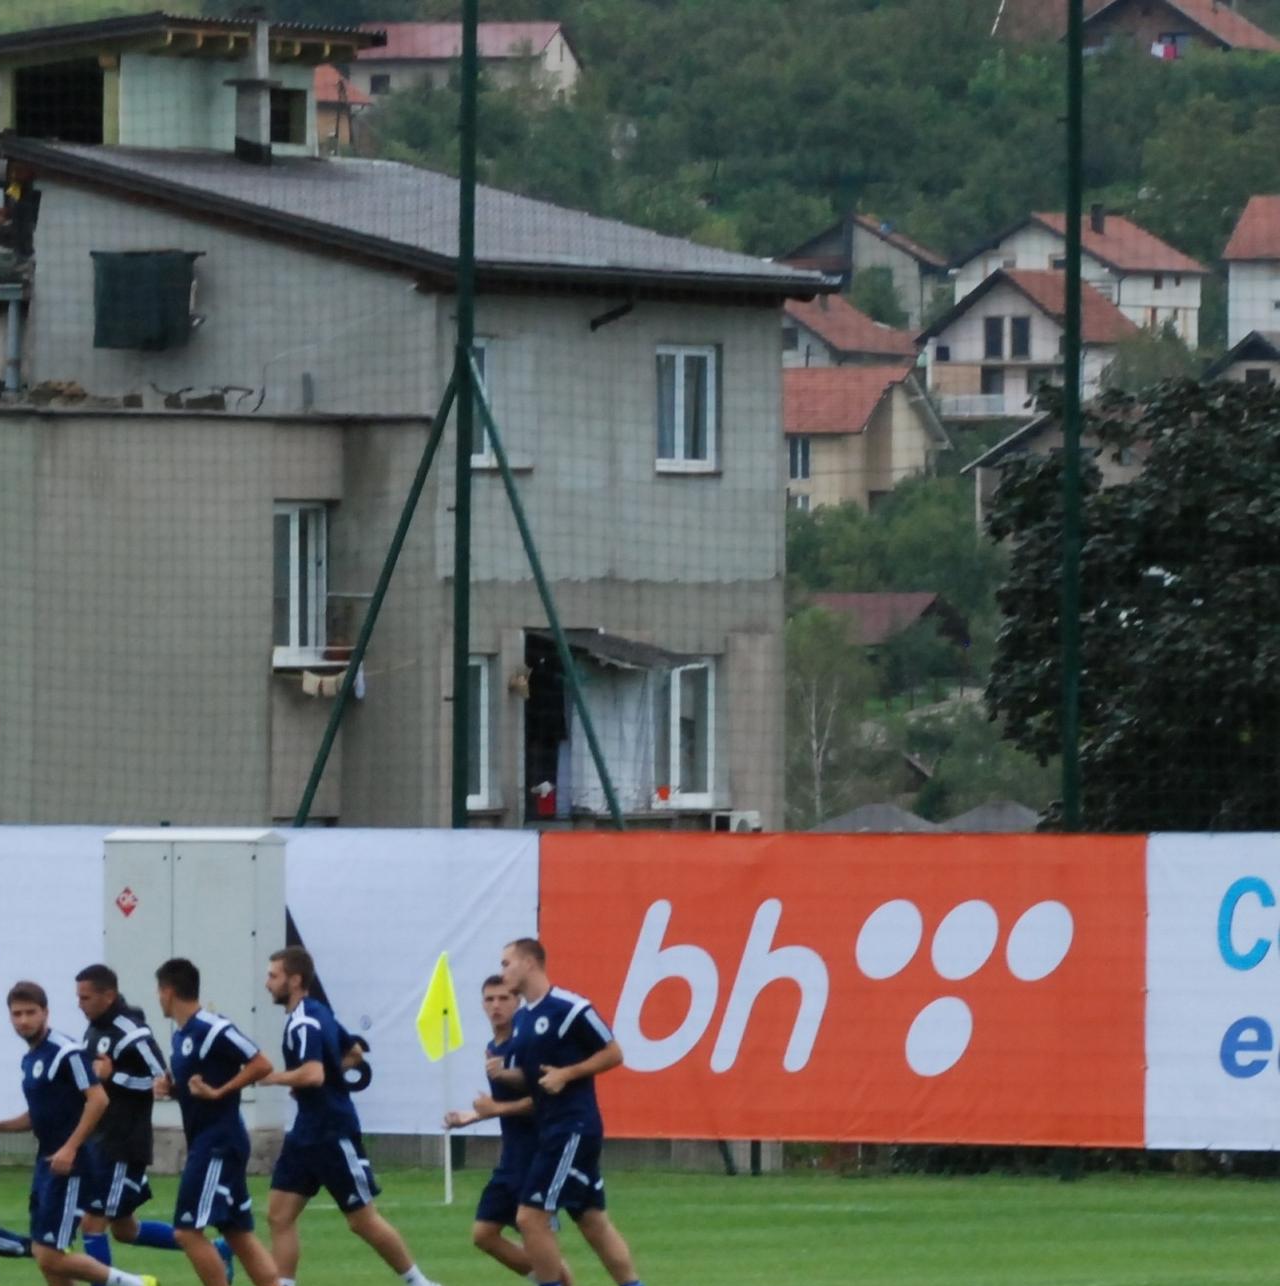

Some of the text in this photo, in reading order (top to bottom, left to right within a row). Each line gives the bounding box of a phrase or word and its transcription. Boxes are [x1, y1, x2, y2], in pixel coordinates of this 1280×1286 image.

[1217, 876, 1280, 972] C
[612, 898, 829, 1073] bh
[1220, 1016, 1280, 1079] e
